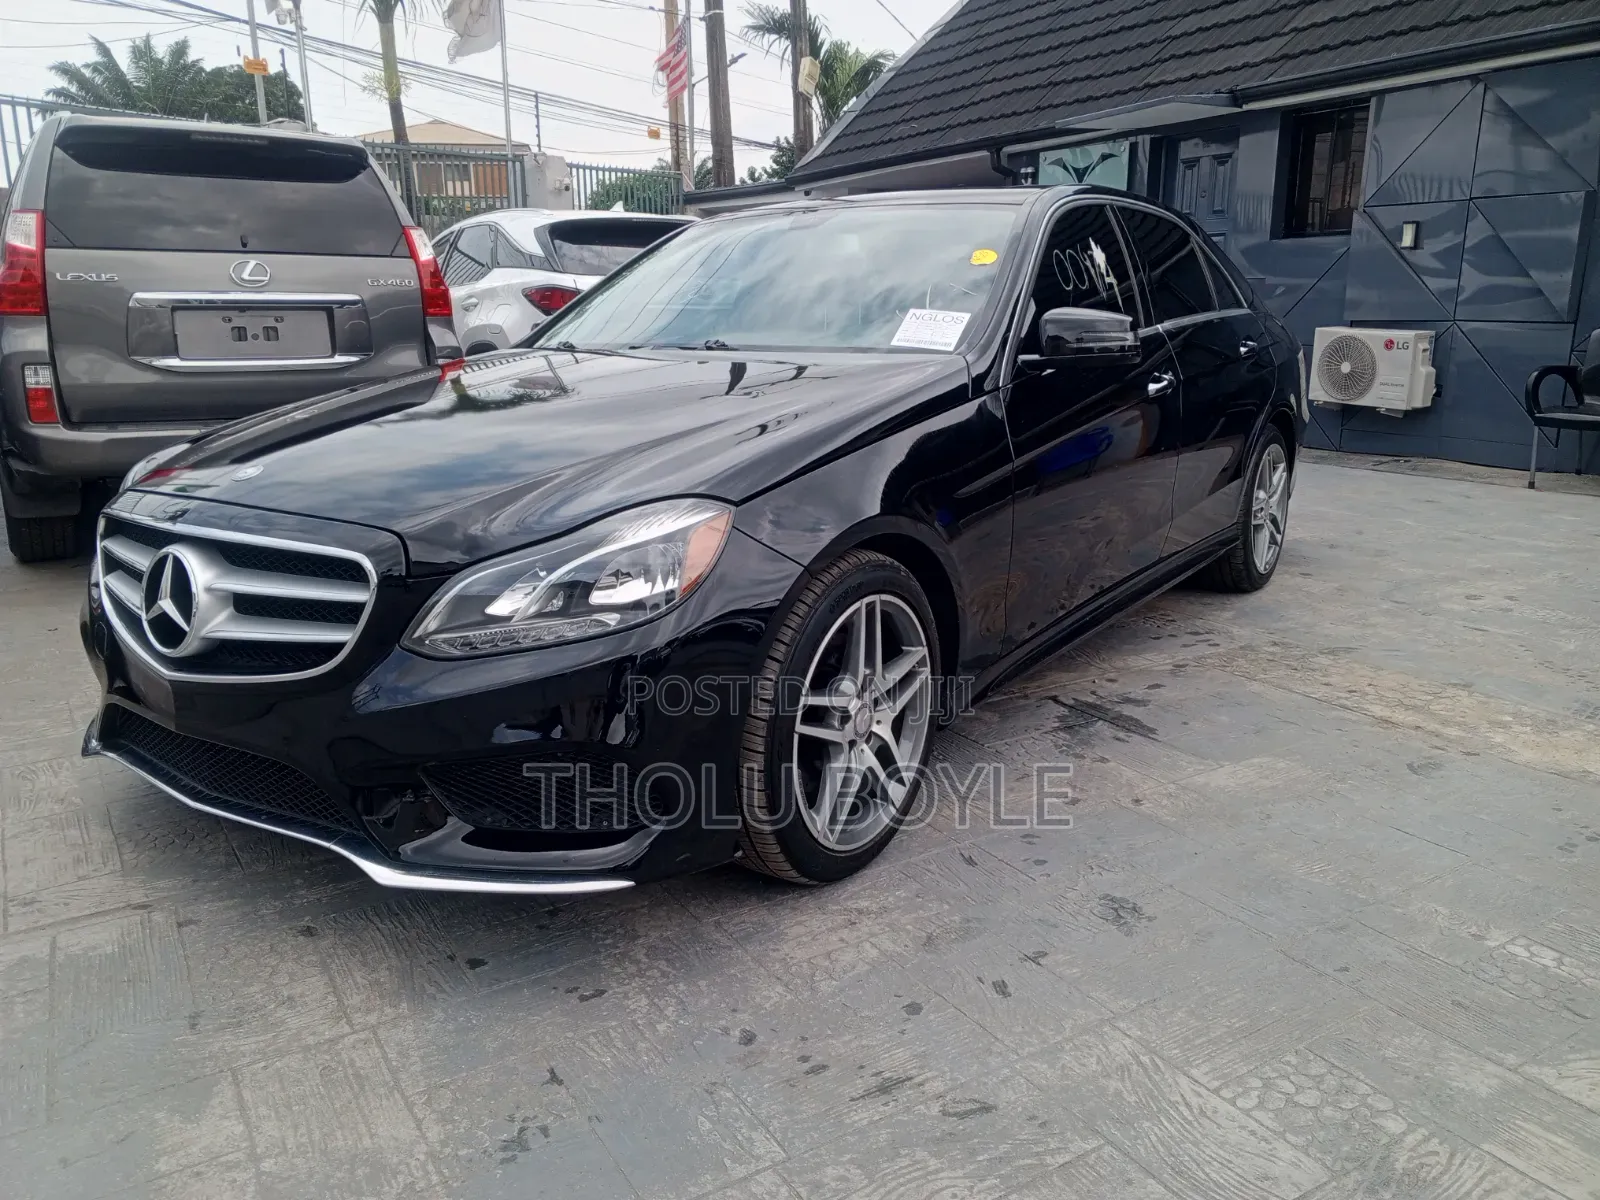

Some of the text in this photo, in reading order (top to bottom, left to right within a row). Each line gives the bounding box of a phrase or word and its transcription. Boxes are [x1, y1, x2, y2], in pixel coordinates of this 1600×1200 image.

[55, 272, 119, 283] LEXUS
[367, 278, 415, 288] GX460
[909, 312, 965, 325] NGLOS
[1396, 340, 1410, 351] LG
